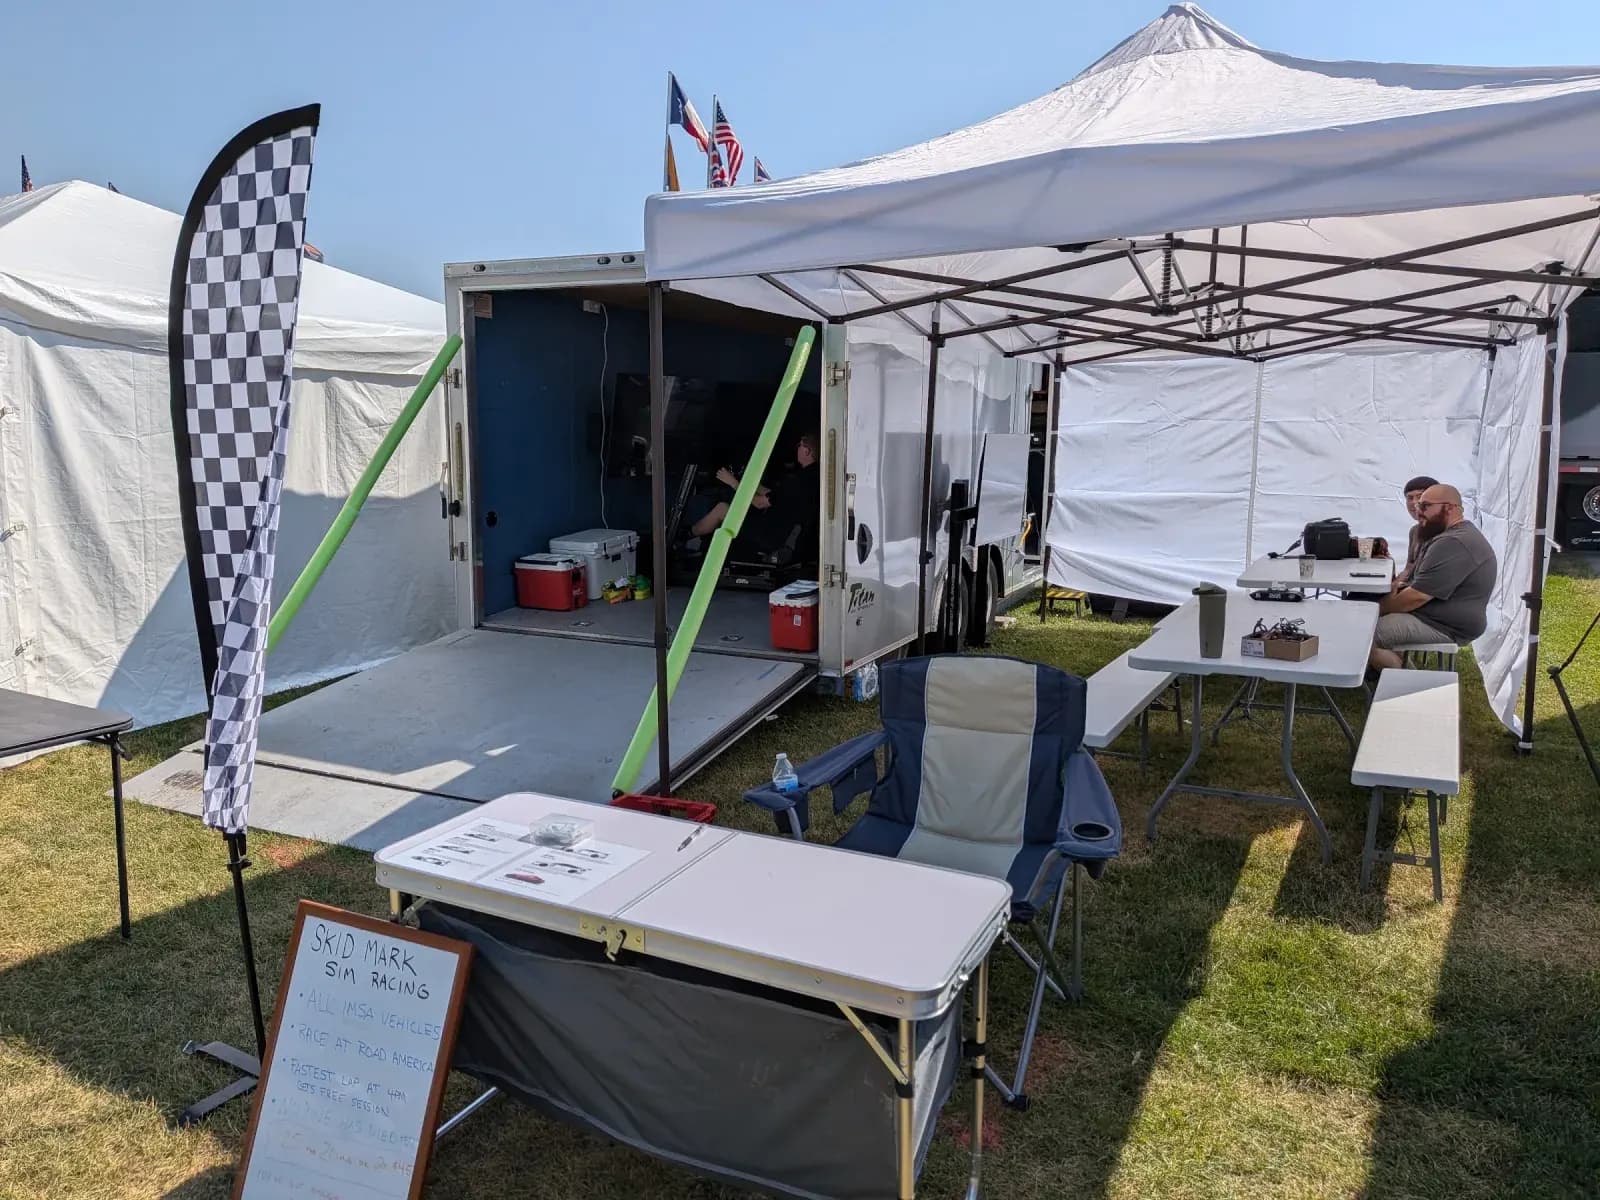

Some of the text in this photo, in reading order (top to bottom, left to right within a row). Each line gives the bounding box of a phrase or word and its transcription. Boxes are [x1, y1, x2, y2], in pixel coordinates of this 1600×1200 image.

[848, 582, 875, 614] Titan
[311, 923, 417, 976] SKID MARK
[325, 961, 430, 1000] SIM RACING
[307, 988, 441, 1041] ALL IMSA VEHICLES
[298, 1023, 435, 1073] RACE AT ROAD AMERICA
[290, 1057, 336, 1082] FASTEST
[366, 1082, 381, 1095] AT
[320, 1086, 347, 1104] FREE
[351, 1098, 390, 1118] SESSION
